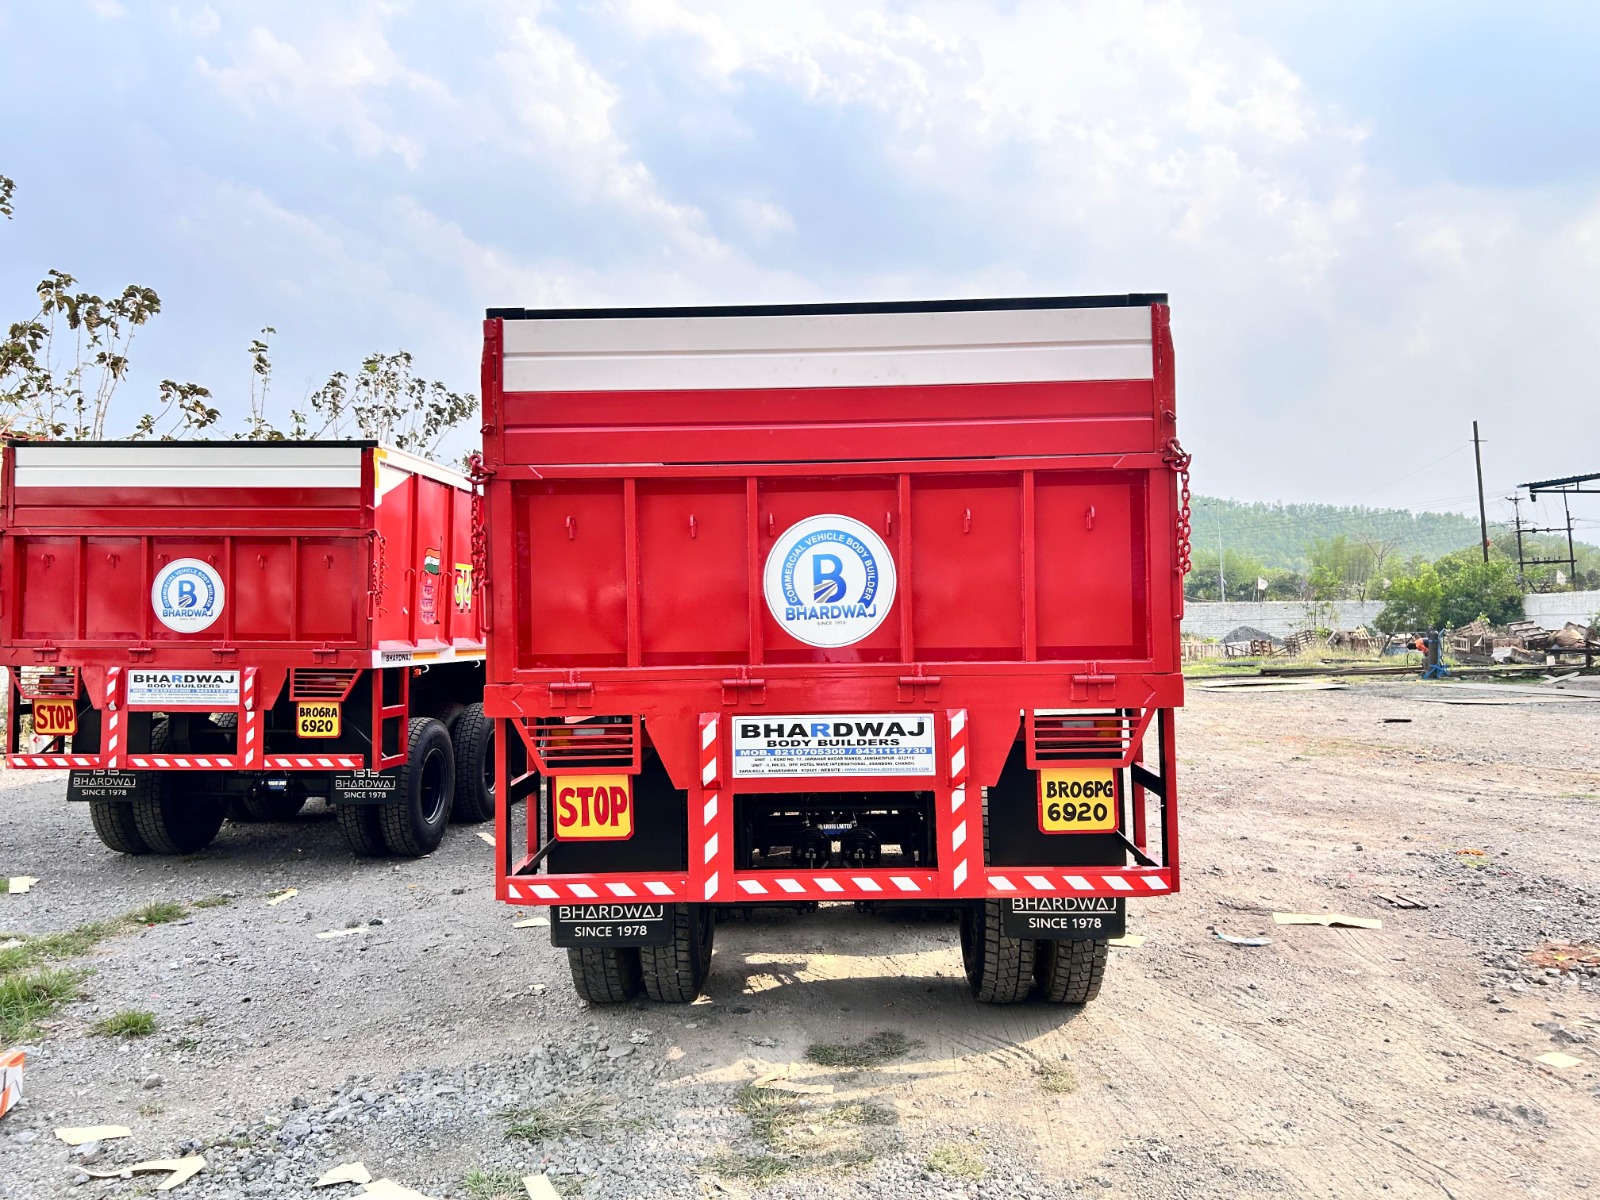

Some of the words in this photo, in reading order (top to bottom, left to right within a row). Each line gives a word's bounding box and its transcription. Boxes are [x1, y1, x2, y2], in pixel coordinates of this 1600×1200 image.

[784, 544, 806, 603] COMMERCIAL
[805, 532, 845, 546] VEHICLE
[846, 537, 869, 559] BODY
[863, 560, 875, 601] BUILDER
[812, 553, 847, 604] B
[178, 580, 197, 608] B
[162, 609, 214, 617] BHARDWAJ
[785, 604, 877, 621] BHARDWAJ
[133, 674, 235, 683] BHARDWAJ
[36, 705, 73, 729] STOP
[299, 707, 338, 718] BR06RA
[301, 719, 333, 732] 6920
[741, 721, 925, 738] BHARDWAJ
[767, 739, 812, 747] BODY
[817, 738, 900, 747] BUILDERS
[774, 748, 845, 756] 8210705300
[855, 747, 927, 755] 9431112730
[73, 777, 136, 786] BHARDWAJ
[335, 779, 396, 788] BHARDWAJ
[1046, 780, 1114, 798] BR06PG
[558, 786, 628, 827] STOP
[1047, 802, 1108, 822] 6920
[1012, 897, 1117, 911] BHARDWAJ
[558, 904, 664, 920] BHARDWAJ
[1028, 918, 1068, 929] SINCE
[1072, 917, 1102, 929] 1978
[574, 926, 612, 937] SINCE
[617, 925, 648, 937] 1978
